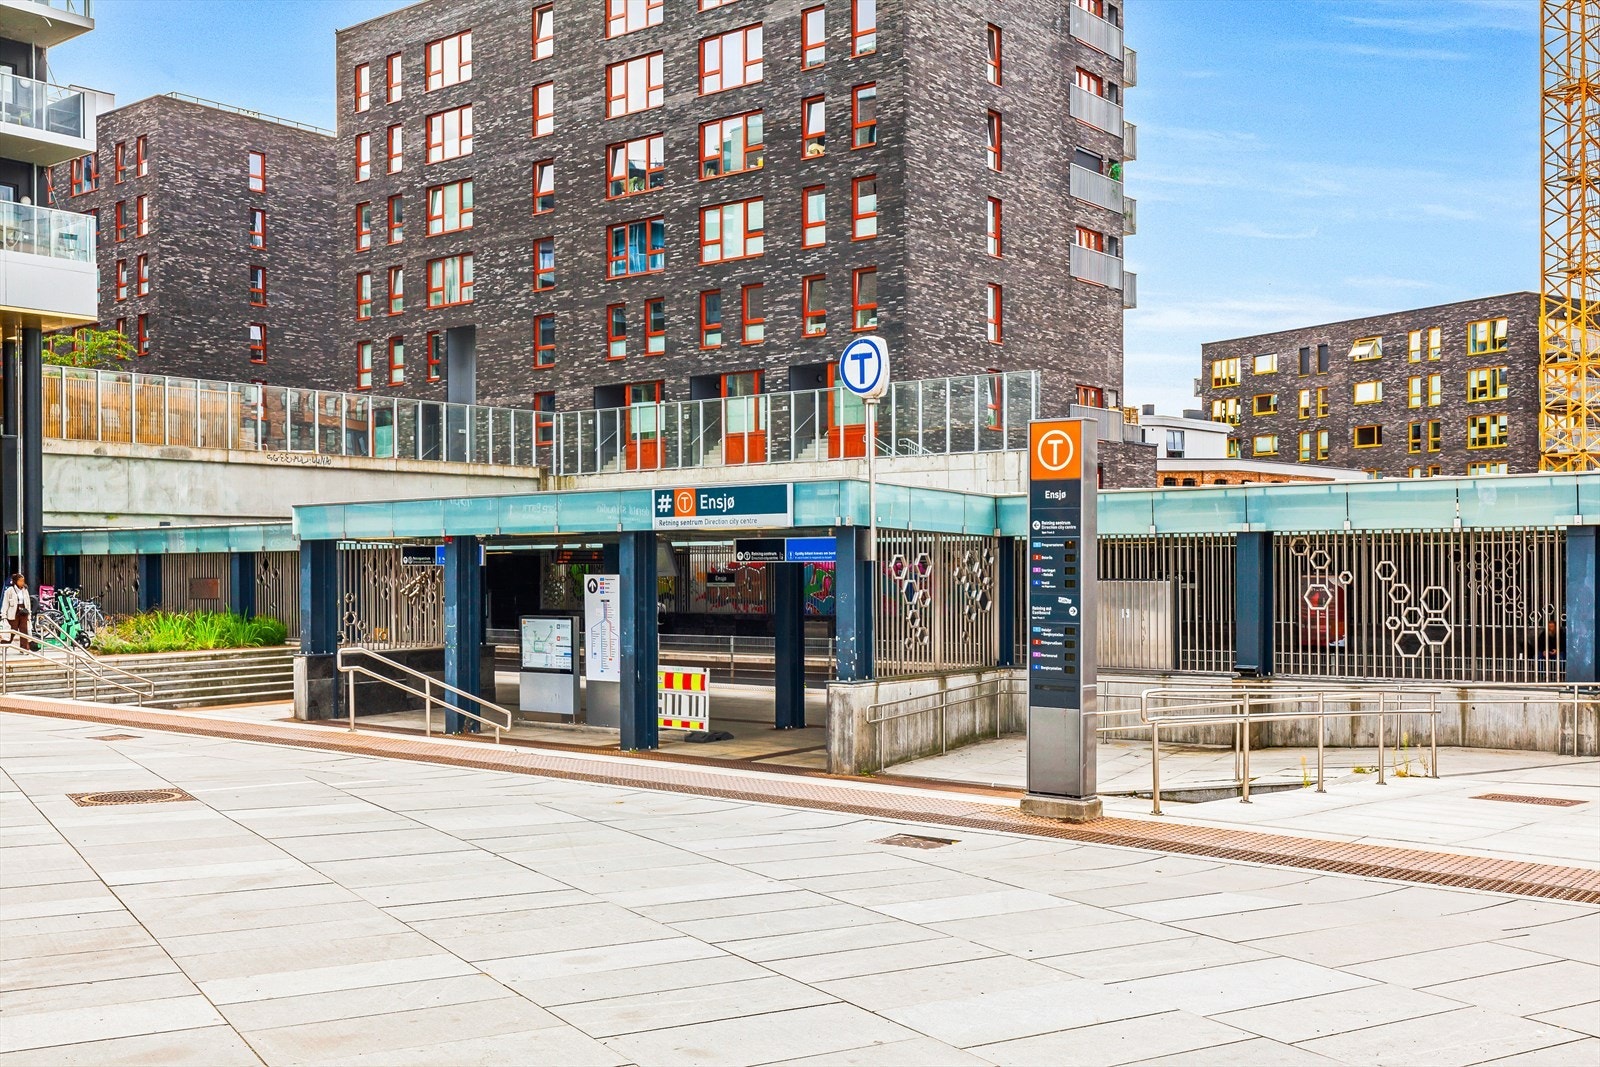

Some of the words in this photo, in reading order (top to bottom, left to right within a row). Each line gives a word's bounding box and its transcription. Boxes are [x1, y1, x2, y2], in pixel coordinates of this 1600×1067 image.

[850, 351, 873, 385] T
[1047, 439, 1064, 465] T
[700, 493, 735, 512] Ensjø
[1044, 490, 1067, 501] Ensjø
[659, 519, 679, 527] Retning
[729, 518, 739, 526] city
